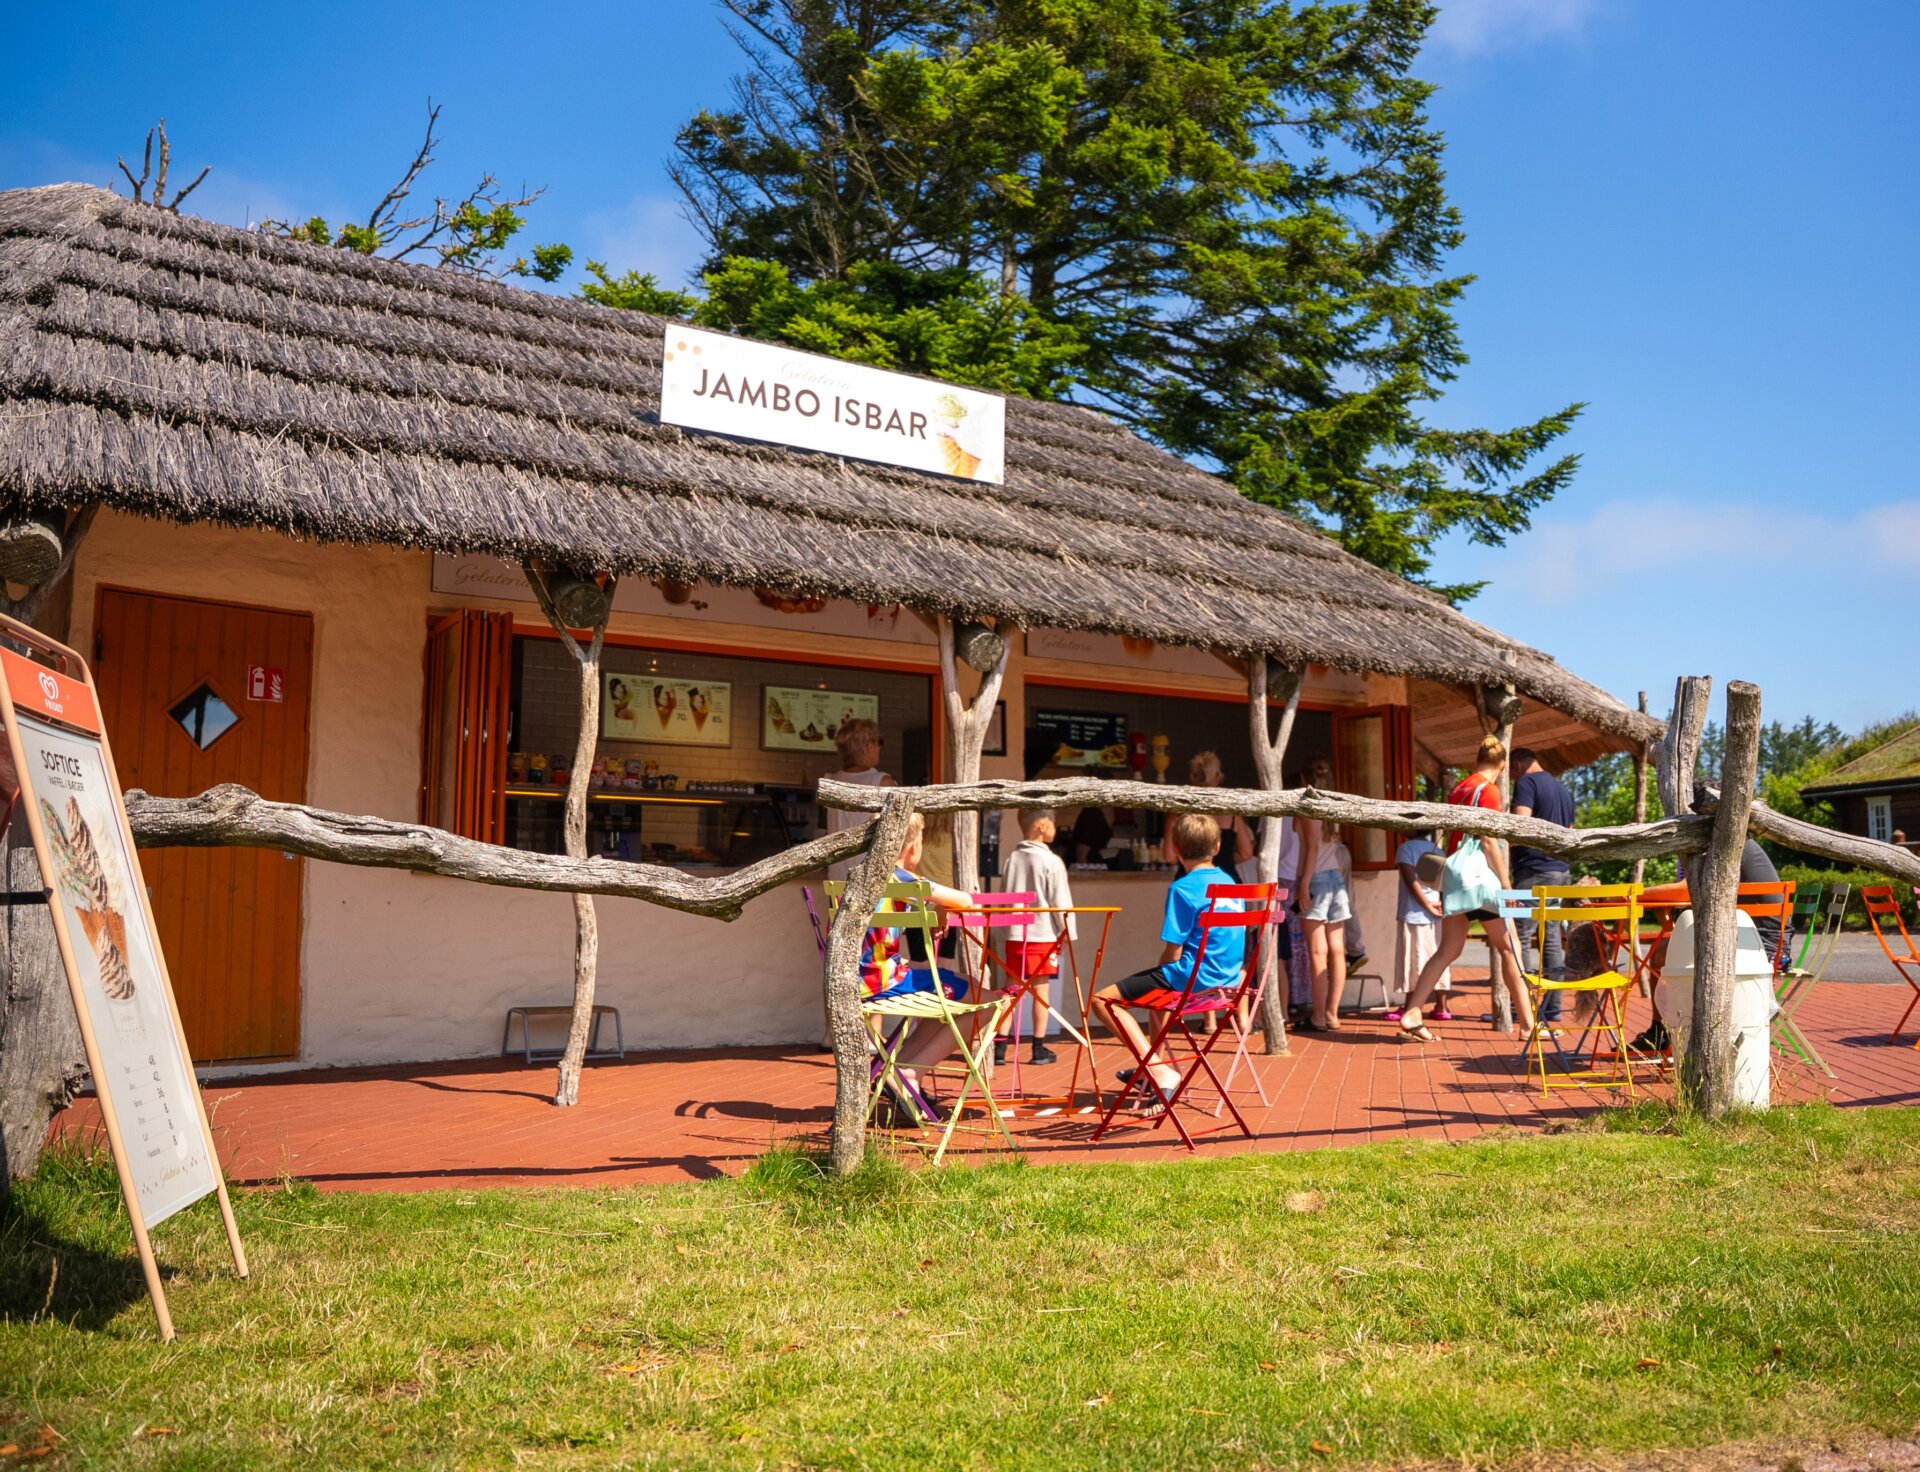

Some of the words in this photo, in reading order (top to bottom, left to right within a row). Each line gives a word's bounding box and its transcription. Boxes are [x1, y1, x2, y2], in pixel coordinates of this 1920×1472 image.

[692, 368, 821, 418] JAMBO
[834, 395, 928, 440] ISBAR
[41, 749, 82, 777] SOFTICE
